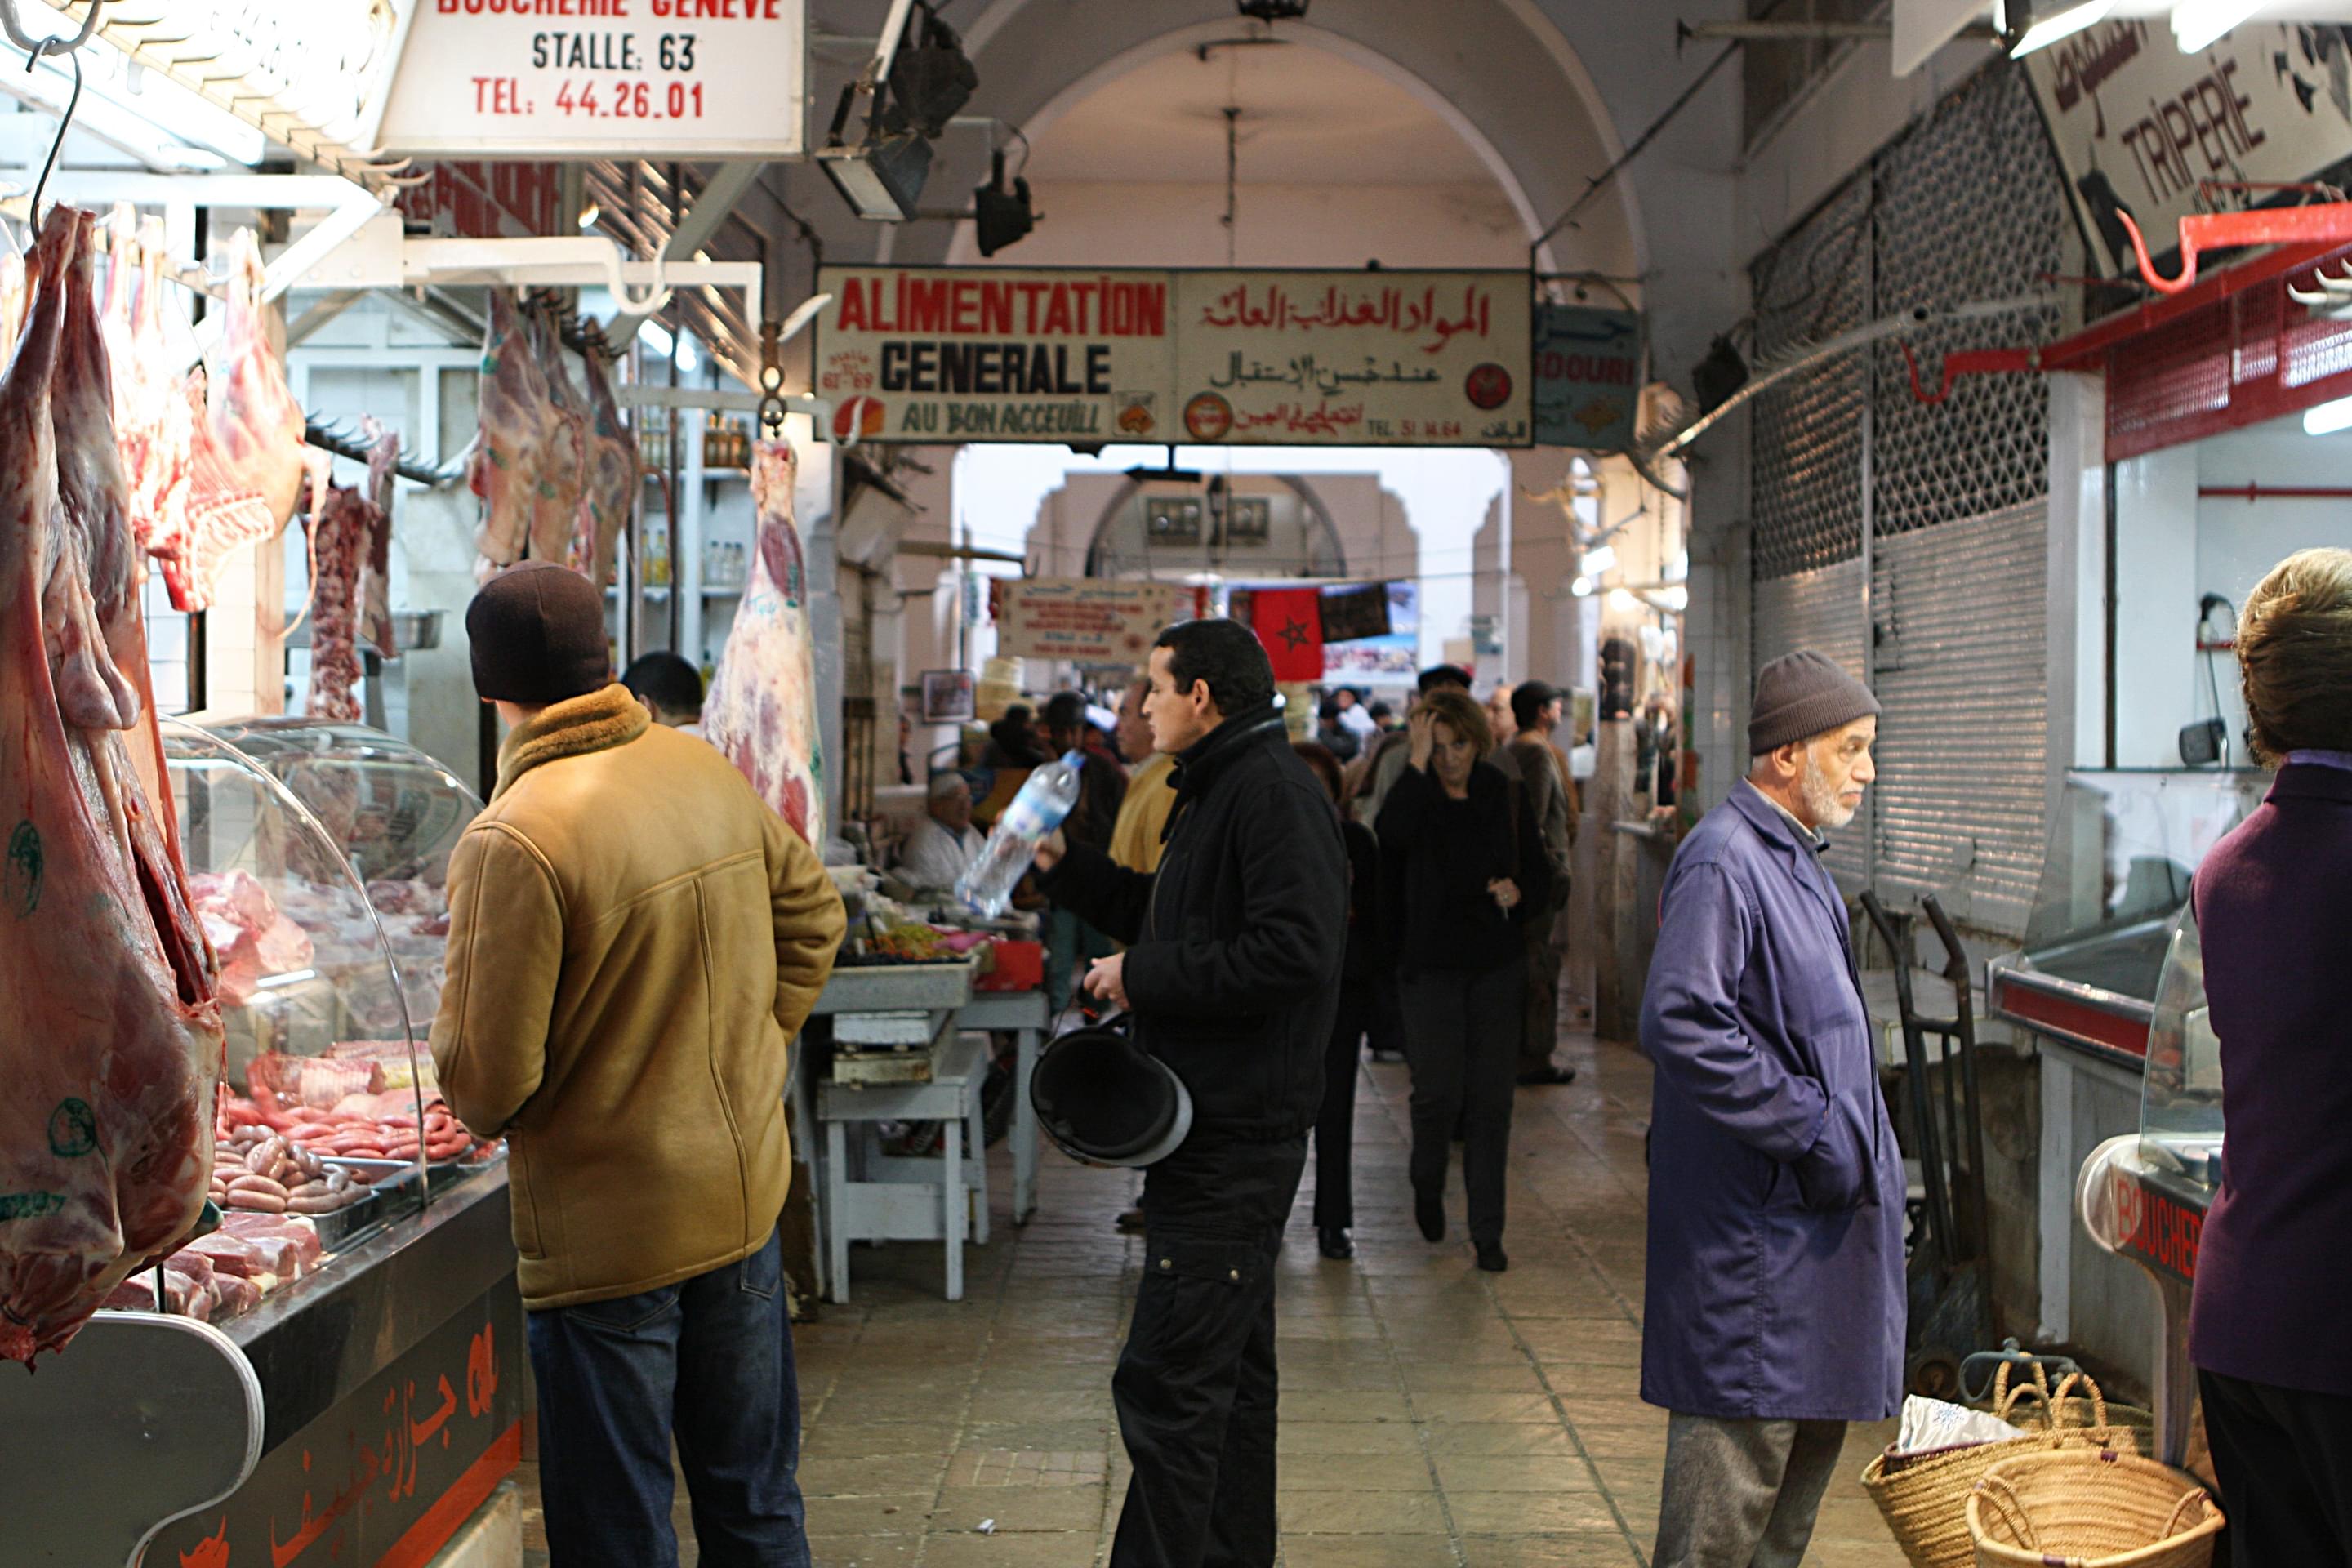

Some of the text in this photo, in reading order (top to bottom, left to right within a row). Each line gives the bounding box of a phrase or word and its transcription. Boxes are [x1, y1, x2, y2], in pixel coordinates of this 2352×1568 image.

[532, 32, 697, 71] STALLE: 63
[471, 77, 533, 114] TEL:
[1403, 283, 1491, 354] المواد
[881, 341, 1111, 394] GENERALE
[902, 402, 938, 431] AU
[946, 402, 996, 434] BON
[2115, 1178, 2209, 1279] BOUCHER
